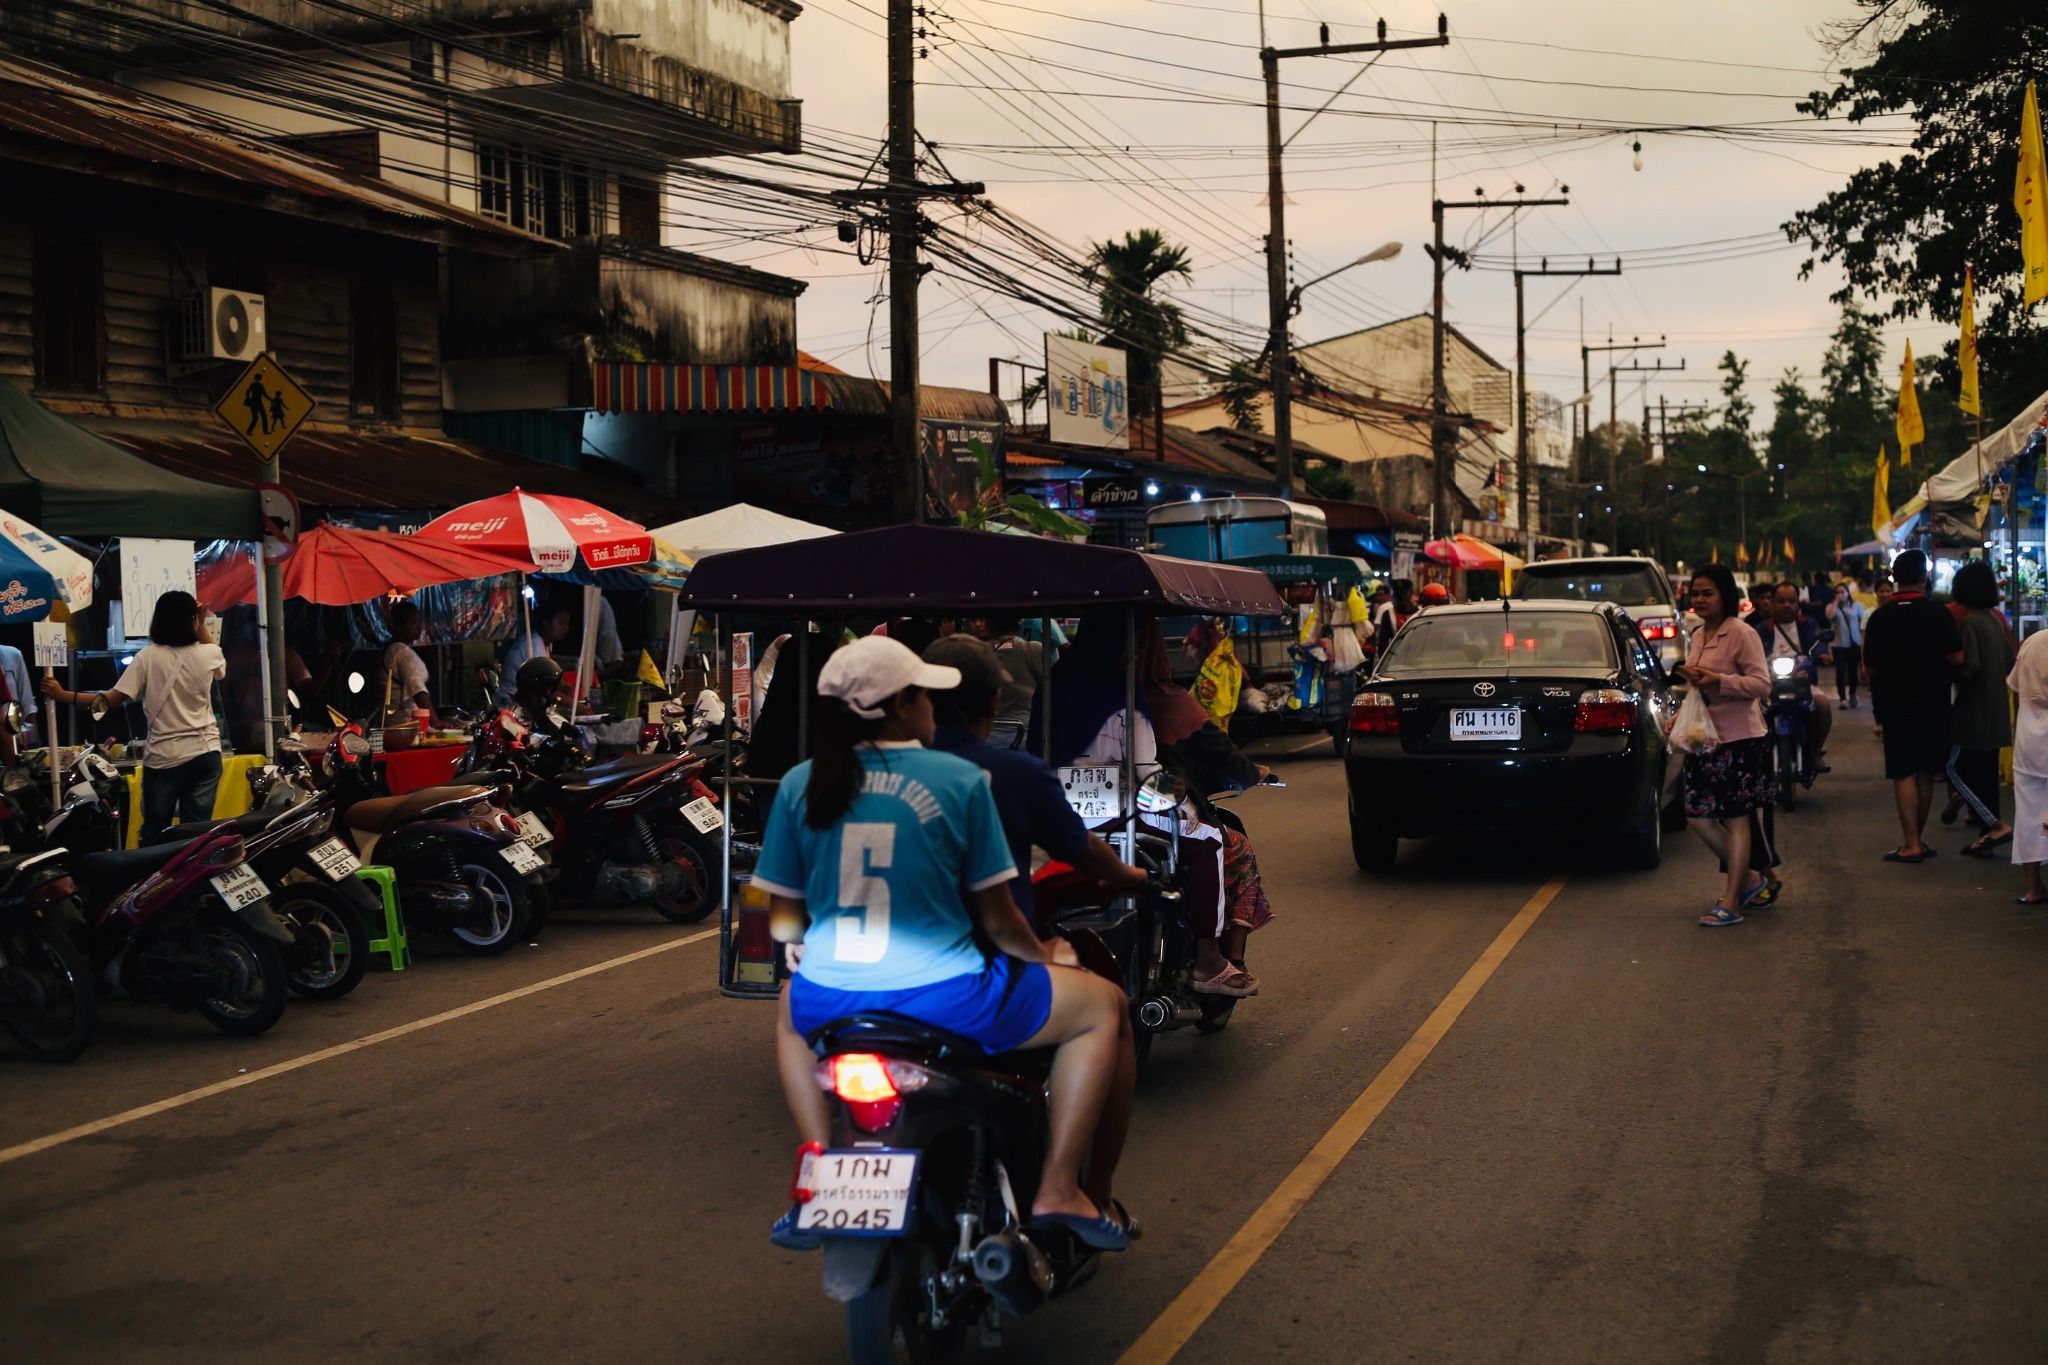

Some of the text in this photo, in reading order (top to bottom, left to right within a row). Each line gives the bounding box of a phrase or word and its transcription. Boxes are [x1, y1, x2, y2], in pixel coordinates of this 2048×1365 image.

[447, 517, 508, 535] meiji
[539, 550, 570, 563] meiji
[1455, 711, 1516, 726] ศน 1116
[860, 771, 905, 796] PORTS
[334, 861, 355, 876] 251
[236, 887, 262, 906] 240
[833, 823, 897, 964] 5
[834, 1157, 892, 1179] 1กม
[812, 1185, 910, 1201] ครศรีธรรมราช
[809, 1208, 892, 1230] 2045
